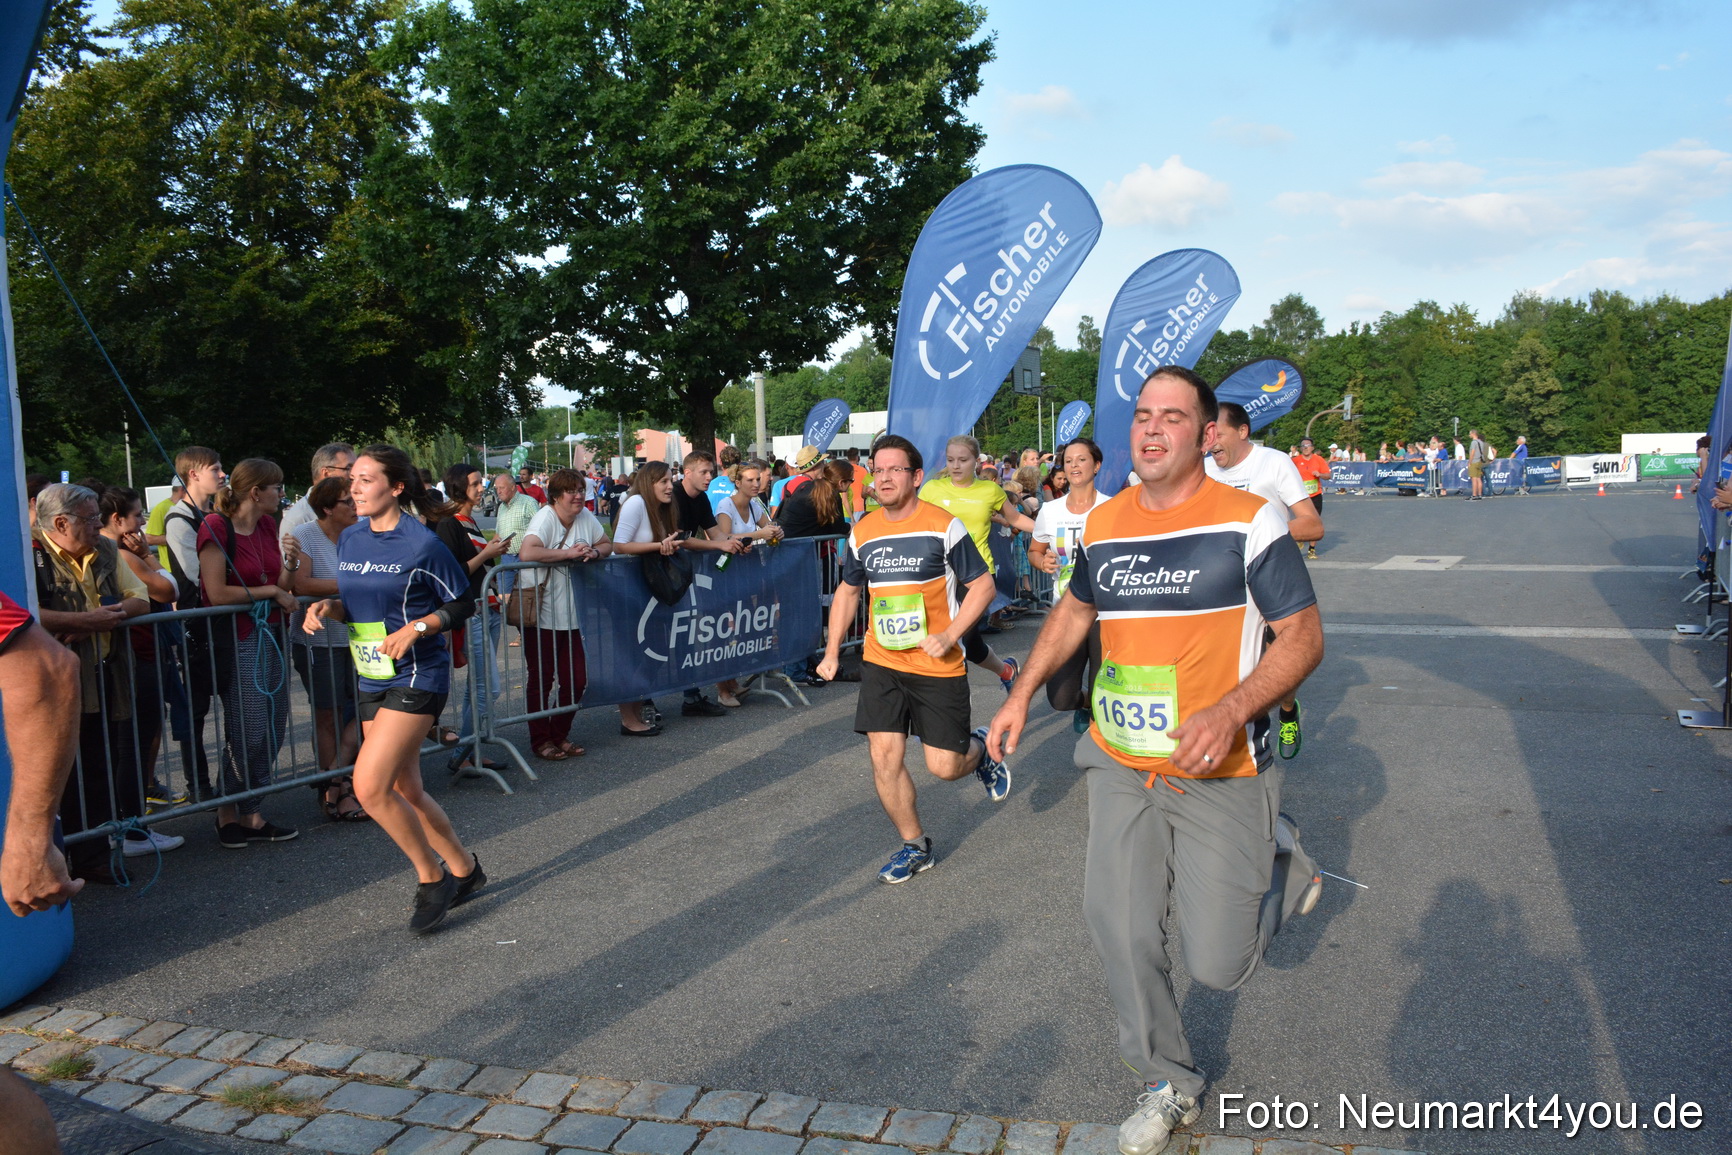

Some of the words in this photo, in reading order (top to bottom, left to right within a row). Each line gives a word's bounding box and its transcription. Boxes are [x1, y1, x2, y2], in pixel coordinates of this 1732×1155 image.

[945, 201, 1057, 354] Fischer
[985, 231, 1070, 353] AUTOMOBILE
[1133, 272, 1209, 380] Fischer
[1164, 292, 1219, 367] UTOMOBILE
[1275, 388, 1299, 406] Medien
[814, 405, 840, 442] Fischer
[1064, 407, 1084, 437] Fischer
[1592, 460, 1620, 474] swn
[1645, 457, 1668, 469] AOK
[1332, 472, 1363, 480] Fischer
[1377, 469, 1414, 477] Frischmann
[339, 561, 363, 572] EURO
[370, 563, 402, 574] POLES
[873, 554, 924, 568] Fischer
[877, 566, 920, 574] AUTOMOBILE
[1110, 567, 1200, 587] Fischer
[1117, 586, 1191, 596] AUTOMOBILE
[669, 600, 781, 649] Fischer
[878, 616, 920, 635] 1625
[355, 645, 381, 664] 354
[681, 635, 774, 669] AUTOMOBILE
[1098, 695, 1168, 731] 1635
